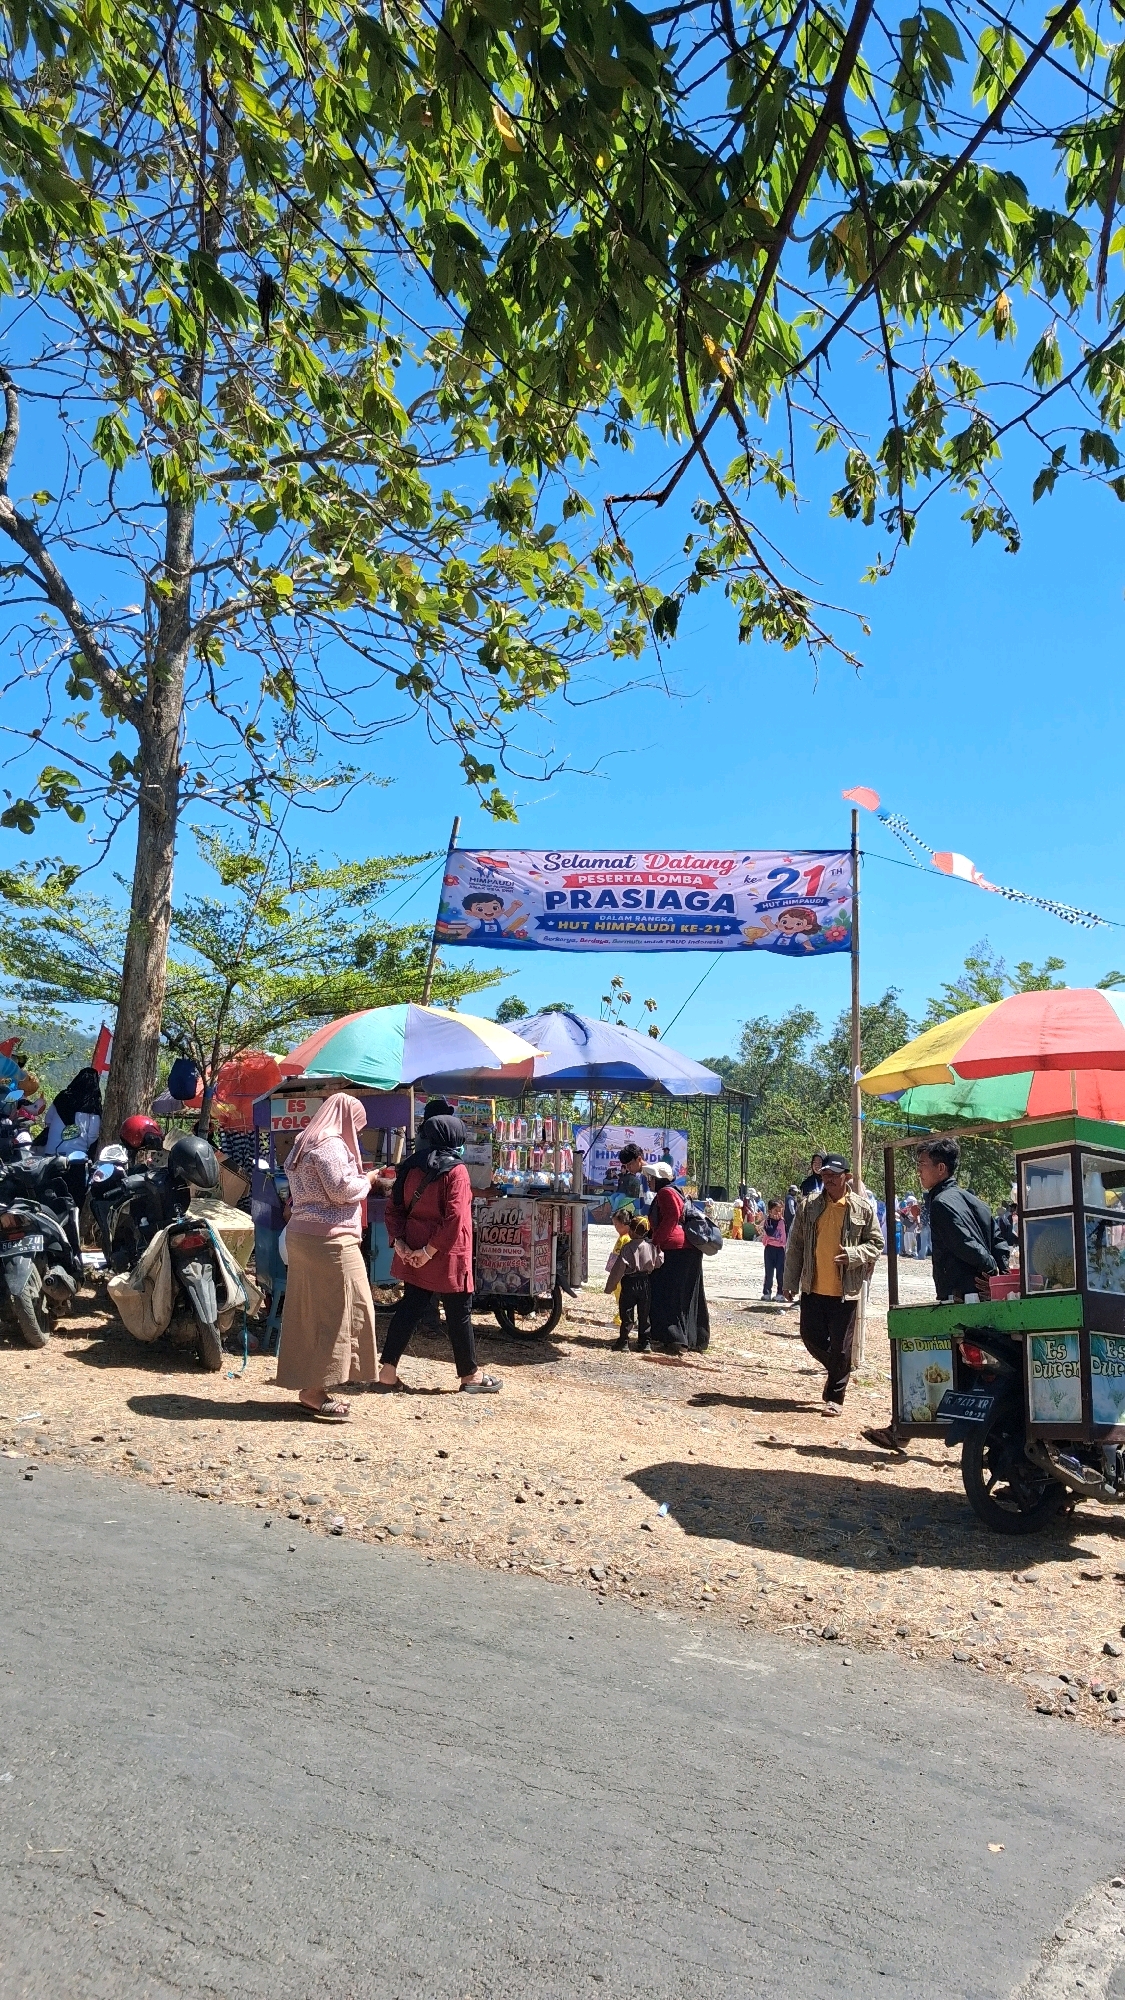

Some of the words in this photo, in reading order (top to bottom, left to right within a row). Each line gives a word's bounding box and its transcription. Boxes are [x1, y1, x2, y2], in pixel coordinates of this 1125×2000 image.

[543, 852, 636, 871] Selamat
[644, 853, 737, 875] Datang
[469, 876, 515, 887] HIMPAUDI
[578, 874, 643, 884] PESERTA
[648, 874, 703, 885] LOMBA
[767, 864, 826, 901] 21
[830, 867, 843, 876] TH
[545, 888, 735, 914] PRASIAGA
[762, 901, 781, 909] HUT
[782, 898, 824, 906] HIMPAUDI
[558, 921, 590, 929] HUT
[594, 921, 676, 932] HIMPAUDI
[680, 923, 720, 933] KE-21
[287, 1099, 307, 1113] ES
[595, 1149, 661, 1163] HIMUDI
[480, 1226, 522, 1245] KOREA
[901, 1339, 914, 1352] Es
[914, 1338, 952, 1351] Durian
[1045, 1340, 1067, 1360] Es
[1032, 1360, 1080, 1379] Duren
